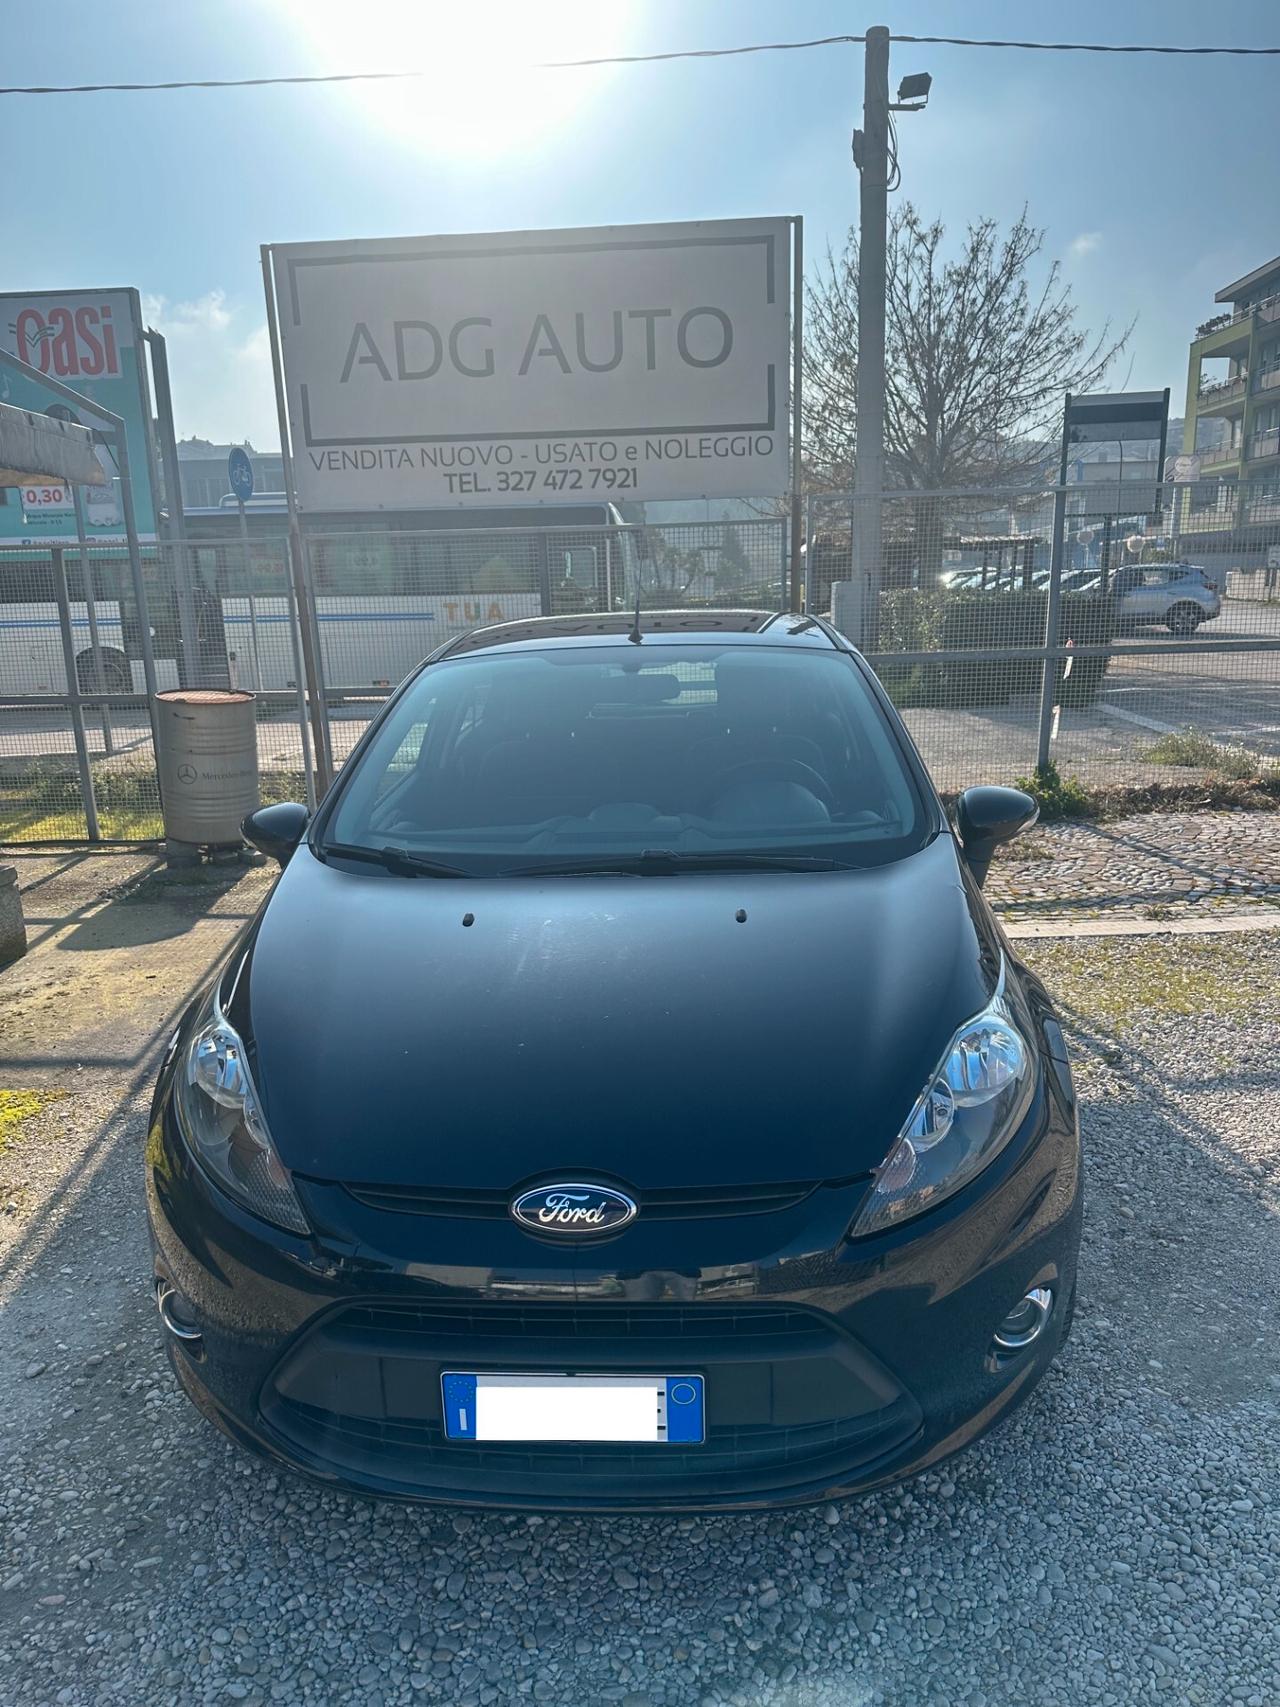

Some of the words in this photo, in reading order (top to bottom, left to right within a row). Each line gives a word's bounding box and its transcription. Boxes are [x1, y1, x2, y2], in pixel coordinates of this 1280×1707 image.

[16, 305, 119, 377] Oasi
[340, 317, 496, 384] ADG
[518, 306, 734, 376] AUTO
[309, 449, 414, 471] VENDITA
[421, 445, 513, 467] NUOVO
[535, 442, 617, 464] USATO
[625, 446, 638, 460] e
[645, 435, 774, 460] NOLEGGIO
[443, 472, 491, 493] TEL.
[497, 471, 537, 492] 327
[543, 469, 583, 490] 472
[588, 467, 638, 489] 7921
[26, 489, 62, 506] 0,30
[442, 602, 504, 623] TUA
[538, 1193, 607, 1224] Ford
[459, 1408, 468, 1431] I
